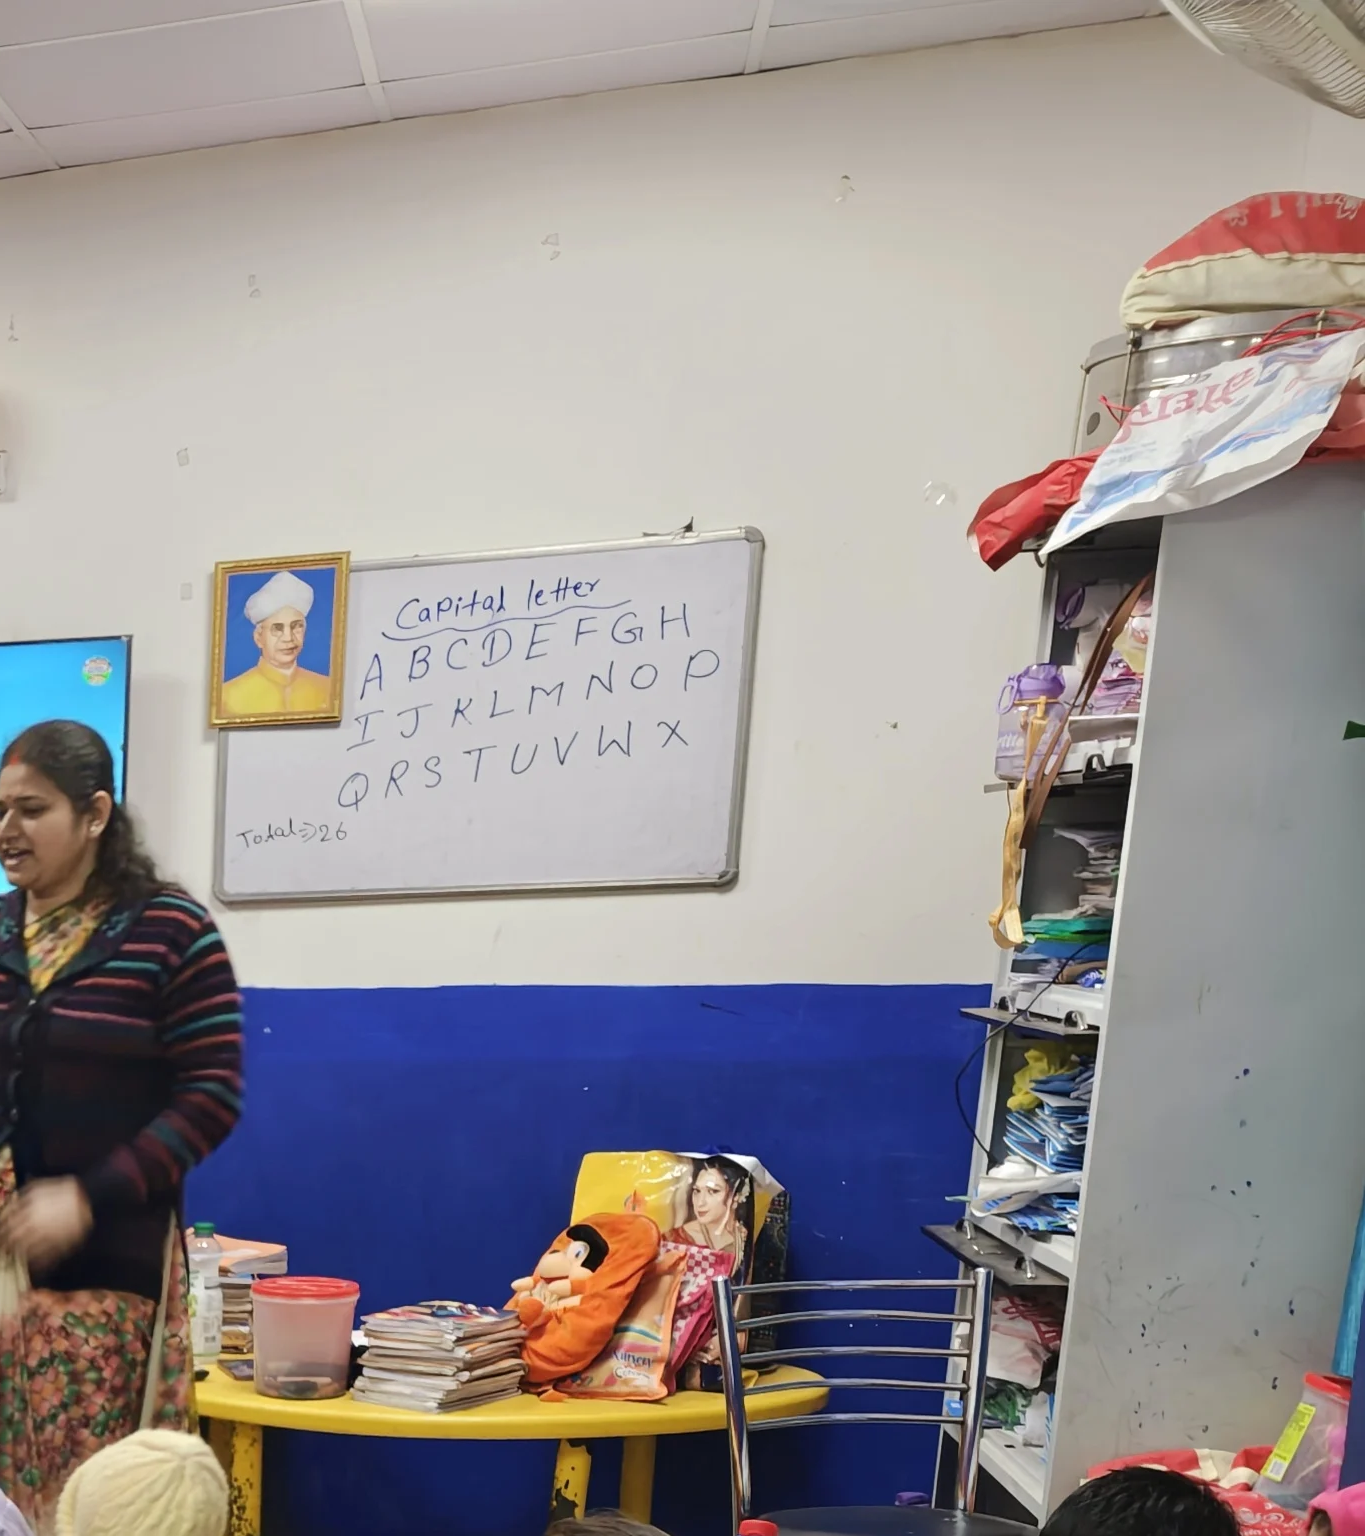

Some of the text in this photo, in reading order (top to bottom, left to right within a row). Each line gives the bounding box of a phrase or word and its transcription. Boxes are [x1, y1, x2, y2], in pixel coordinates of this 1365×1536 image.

[395, 577, 602, 630] Capital letter
[359, 602, 691, 700] A B C D E F G H
[346, 649, 721, 752] I J K L M N O P
[337, 719, 689, 812] Q R S T U V W X
[236, 817, 297, 848] Total
